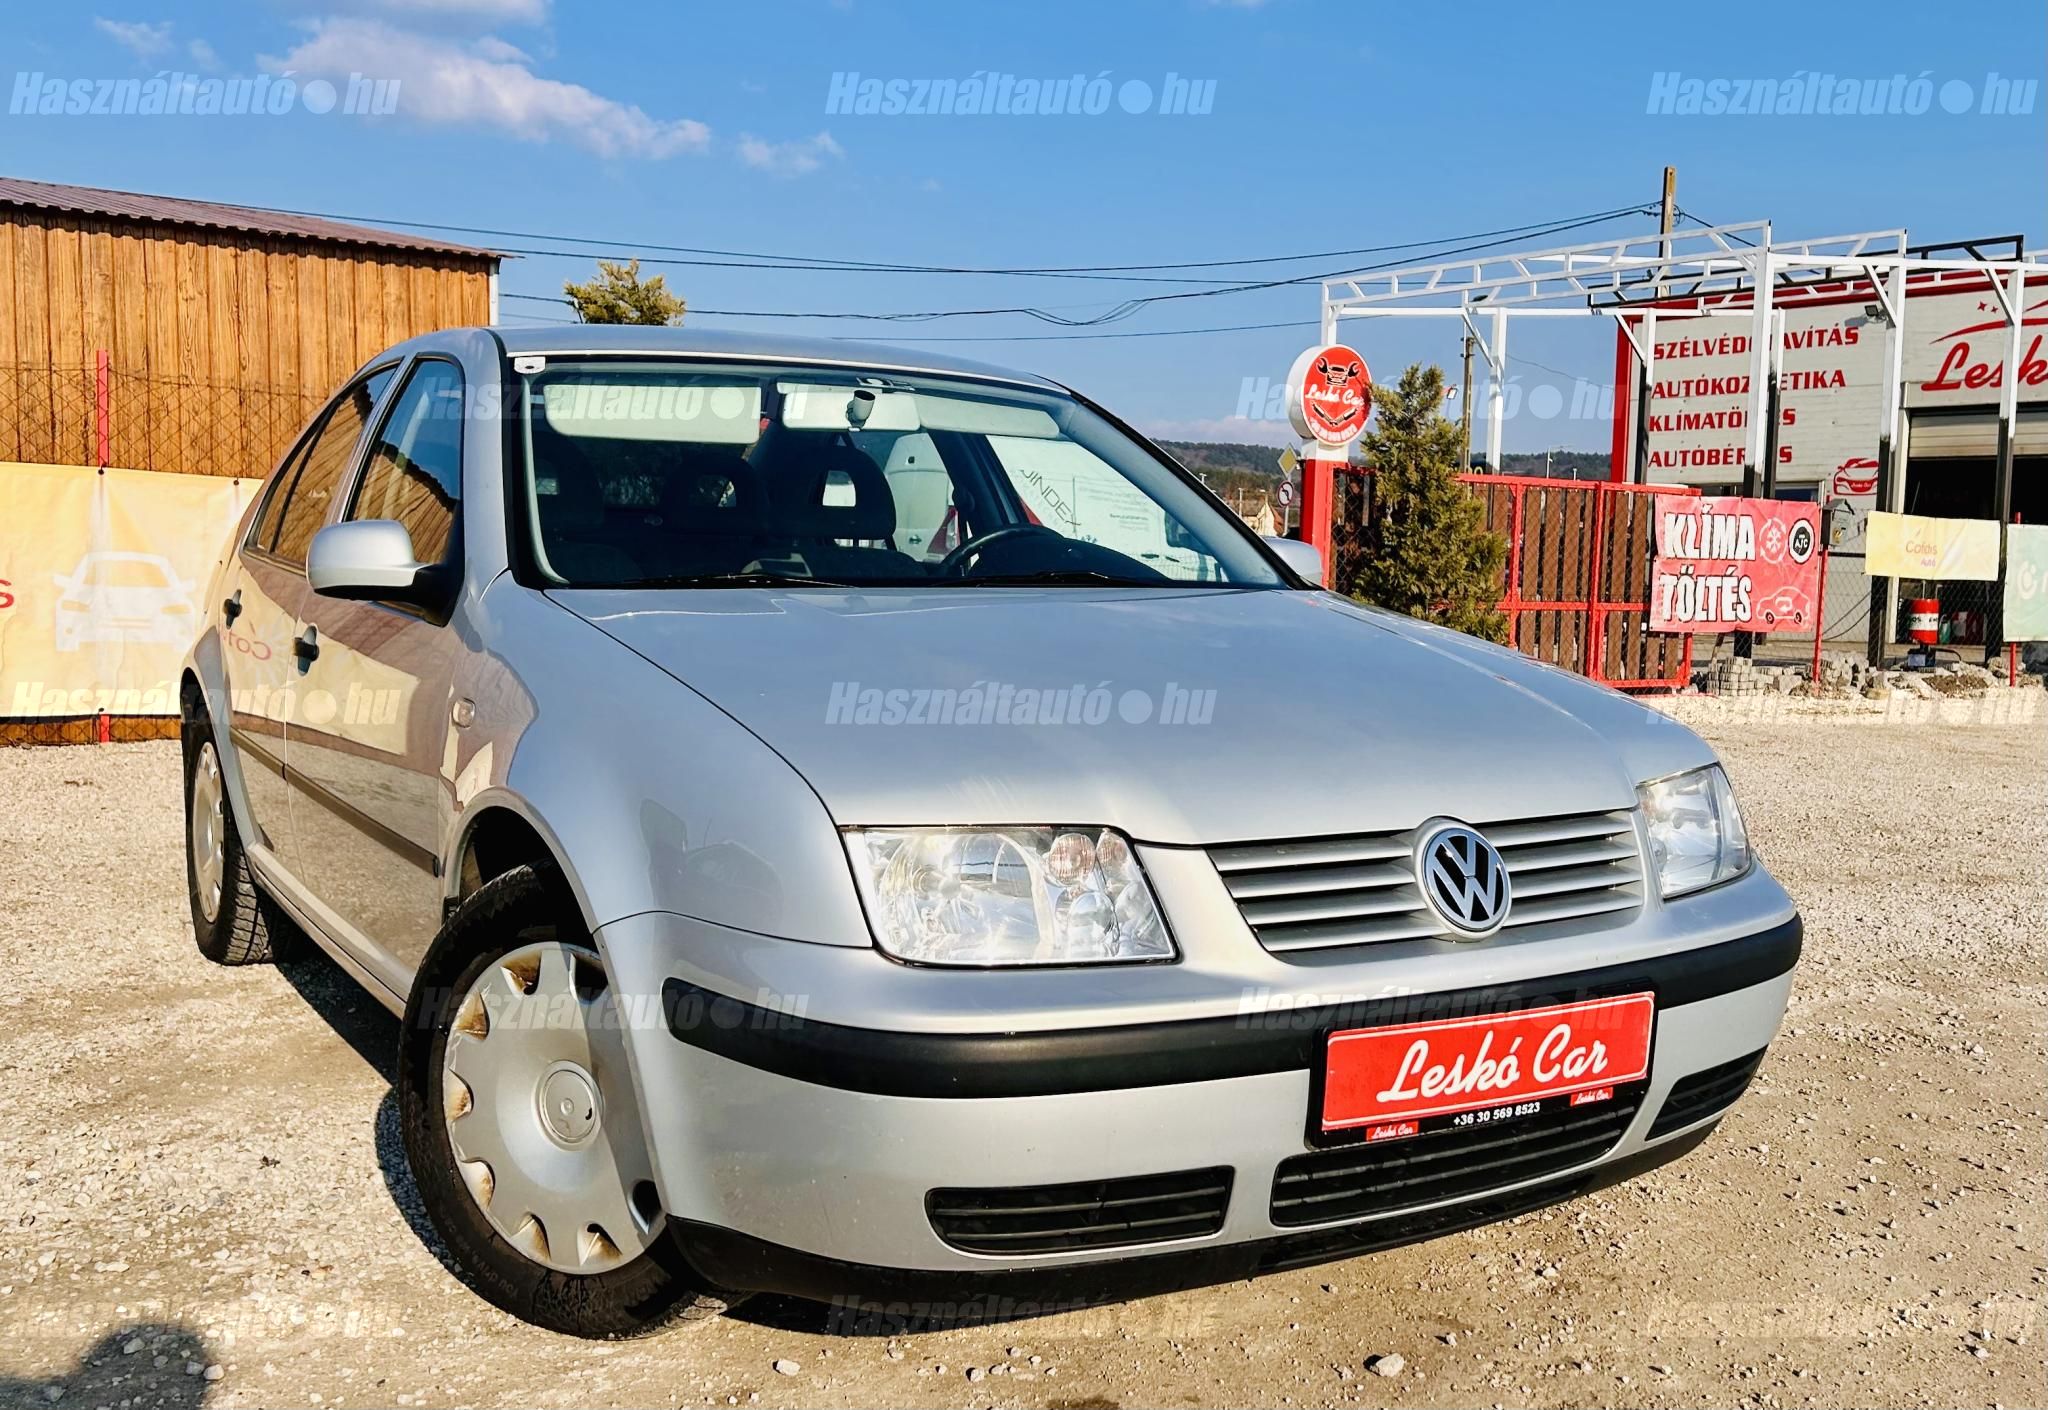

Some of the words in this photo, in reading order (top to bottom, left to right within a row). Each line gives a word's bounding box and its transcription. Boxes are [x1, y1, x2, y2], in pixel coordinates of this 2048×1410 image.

[1654, 332, 1752, 360] SZÉLVÉD
[1769, 322, 1860, 351] AVÍTÁS
[1651, 368, 1847, 399] AUTÓKOZETIKA
[1649, 406, 1797, 432] KLÍMATÖS
[1647, 442, 1793, 468] AUTÓBÉRS
[1664, 503, 1756, 561] KLÍMA
[1659, 564, 1753, 623] TÖLTÉS
[1376, 1030, 1524, 1103] Leskó
[1532, 1023, 1609, 1083] Car
[1453, 1113, 1475, 1126] +36
[1476, 1111, 1490, 1123] 30
[1493, 1107, 1513, 1120] 569
[1515, 1101, 1541, 1116] 8523
